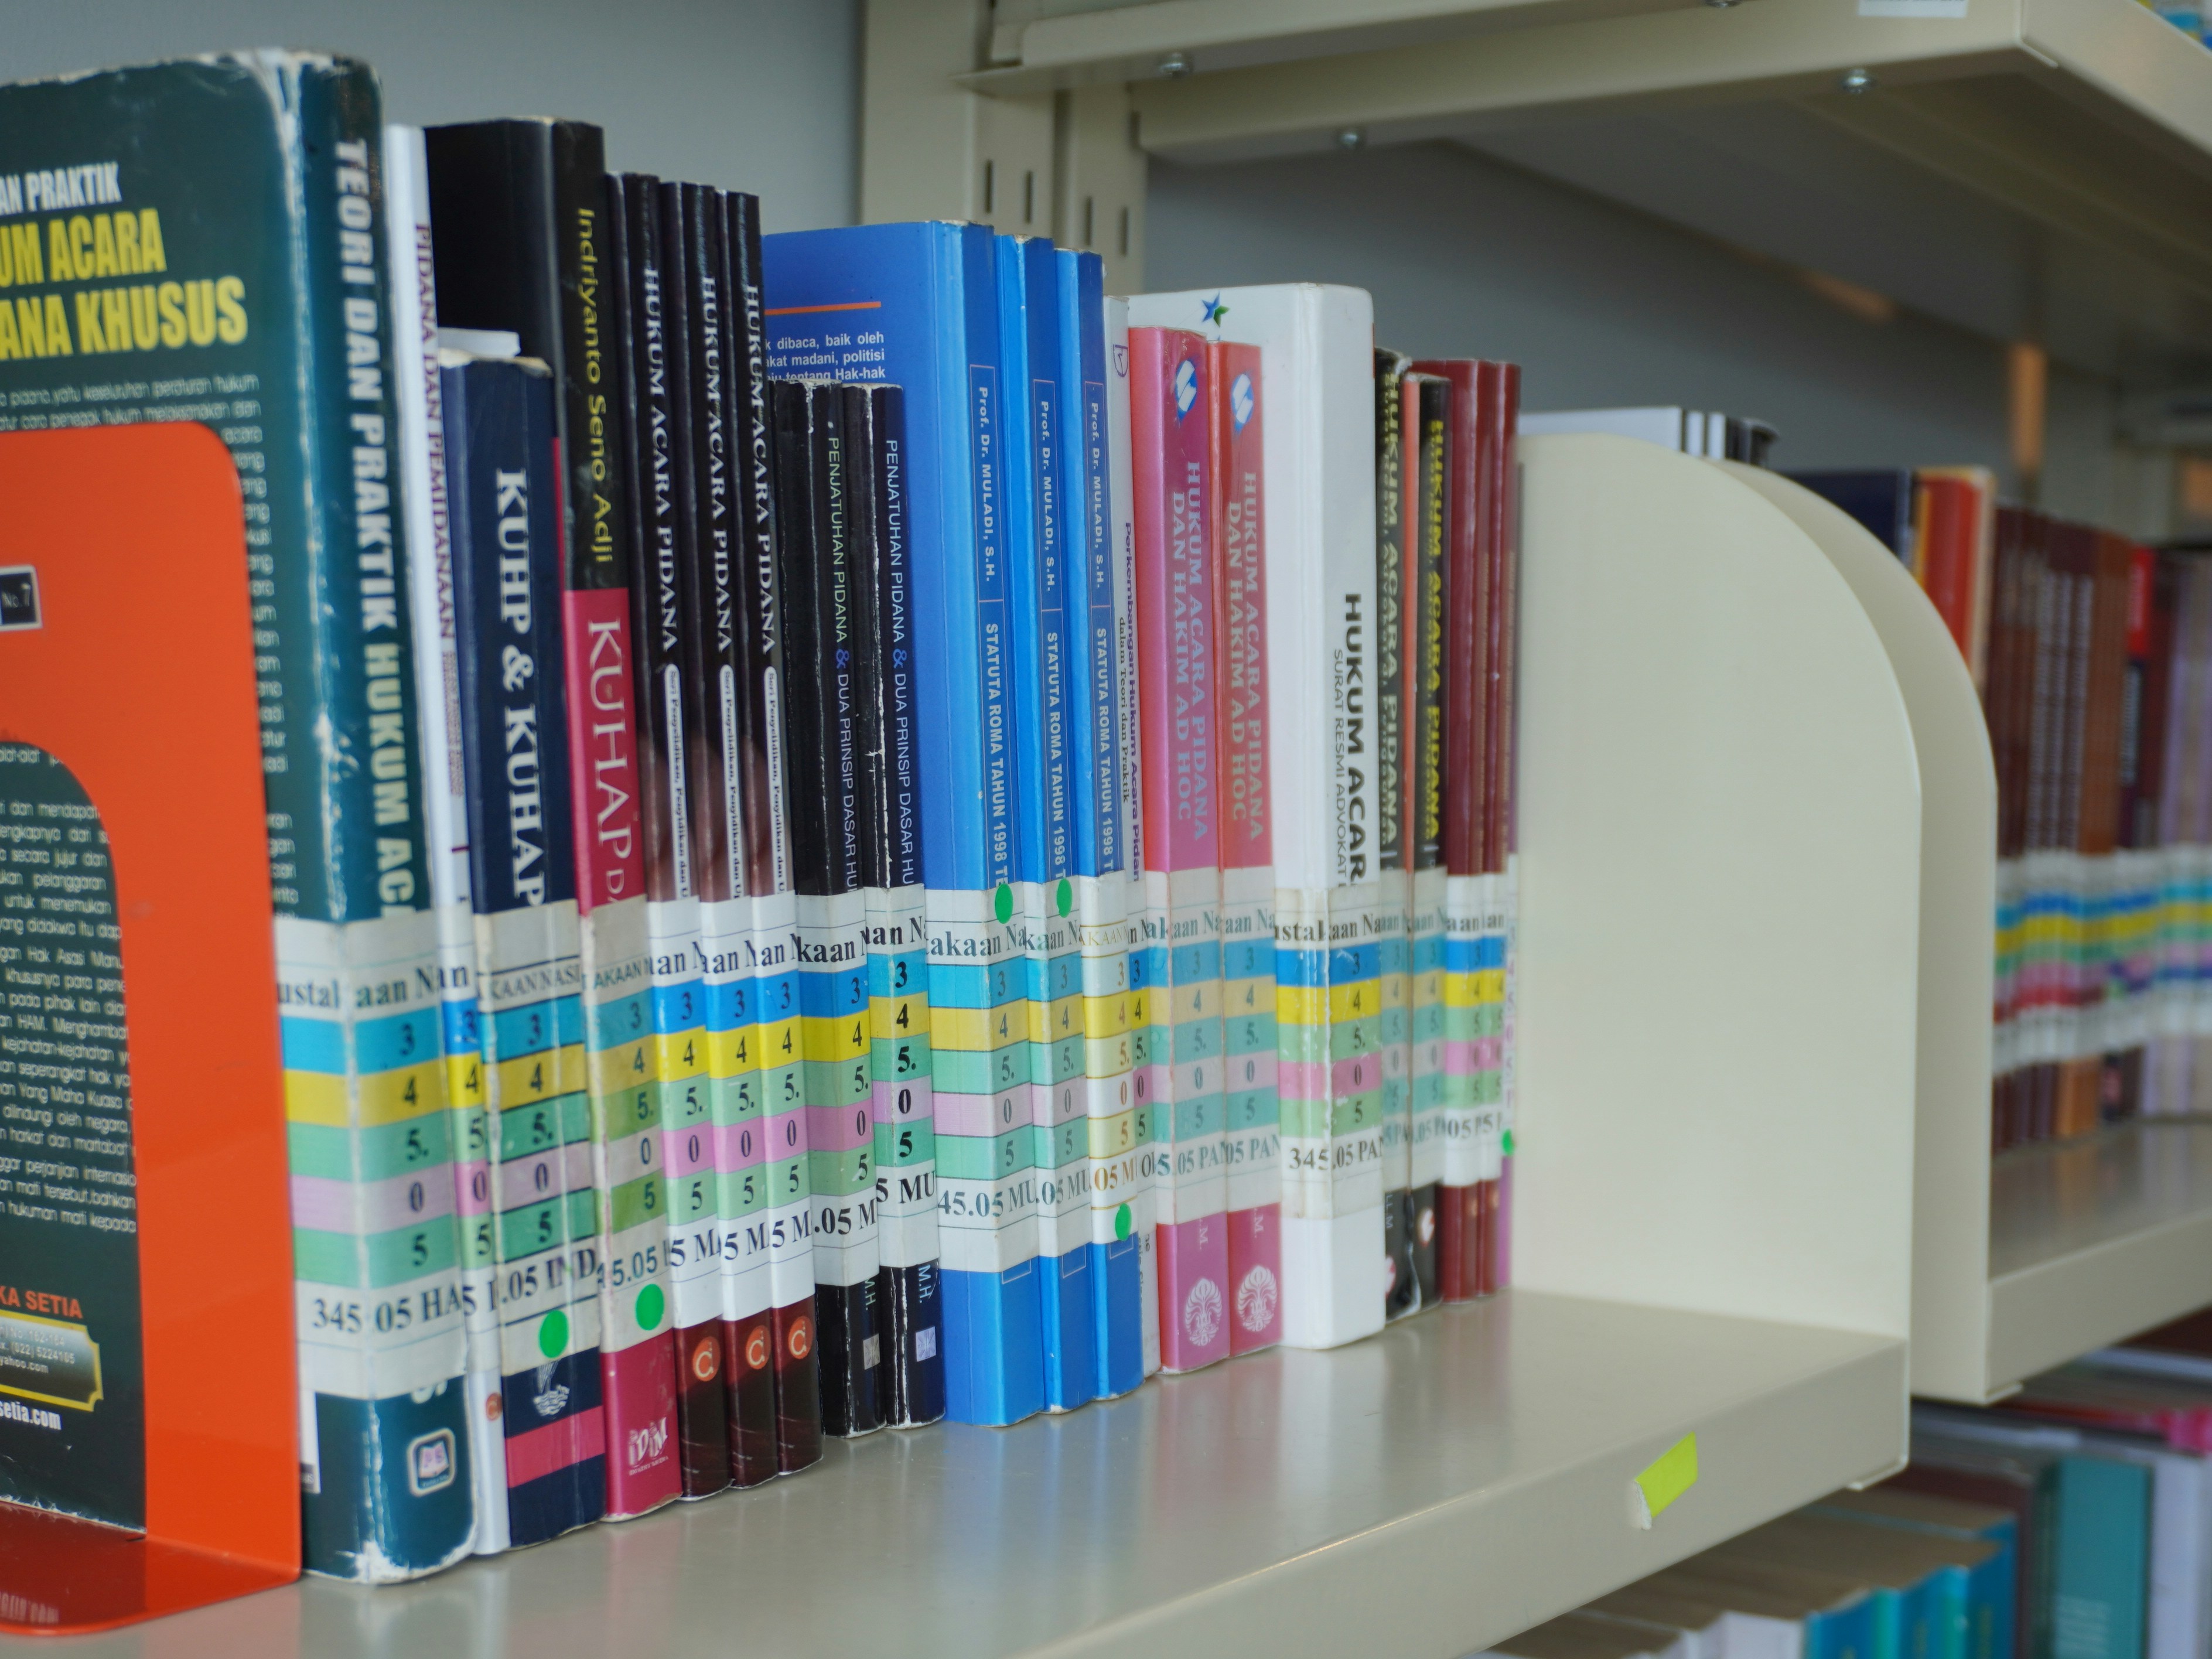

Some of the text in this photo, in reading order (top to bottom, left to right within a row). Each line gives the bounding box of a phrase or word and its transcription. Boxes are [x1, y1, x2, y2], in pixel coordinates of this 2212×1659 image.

[25, 161, 122, 212] PRAKTIK
[335, 137, 375, 285] TEORI
[50, 208, 167, 282] ACARA
[415, 224, 438, 343] PIDANA
[76, 276, 248, 354] KHUSUS
[777, 332, 884, 350] dibaca, baik oleh
[344, 298, 383, 400] DAN
[792, 349, 885, 366] madani, politisi
[836, 366, 886, 380] Hak-hak
[424, 354, 442, 419] DAN
[578, 209, 613, 561] Indriyanto Seno Adji
[644, 267, 678, 653] HUKUM ACARA PIDANA
[703, 276, 732, 652] HUKUM ACARA PIDANA
[746, 284, 776, 654] HUKUM ACARA PIDANA
[1092, 448, 1100, 470] Dr.
[351, 414, 398, 631] PRAKTIK
[886, 439, 902, 566] PENJATUHAN
[1094, 476, 1102, 548] MULADI,
[428, 433, 455, 638] PEMIDANAAN
[892, 571, 905, 643] PIDANA
[979, 387, 1007, 861] Prof. Dr. MULADI, S.H. STATUTA ROMA TAHUN 1998
[1041, 401, 1065, 865] Prof. Dr. MULADI, S.H. STATUTA ROMA TAHUN 1998
[828, 436, 856, 858] PENJATUHAN PIDANA & DUA PRINSIP DASAR
[893, 648, 907, 669] &
[1097, 629, 1109, 702] STATUTA
[1173, 491, 1191, 820] DAN HAKIM AD HOC
[1188, 461, 1208, 841] HUKUM ACARA PIDANA
[1228, 502, 1246, 821] DAN HAKIM AD HOC
[1245, 472, 1264, 841] HUKUM ACARA PIDANA
[1346, 593, 1364, 753] HUKUM
[497, 469, 545, 907] KUHP & KUHAP
[895, 674, 906, 711] DUA
[364, 643, 409, 826] HUKUM
[588, 620, 632, 859] KUHAP
[896, 717, 910, 787] PRINSIP
[1100, 706, 1110, 753] ROMA
[1101, 757, 1112, 813] TAHUN
[1333, 649, 1347, 876] SURAT RESMI ADVOKAT
[899, 793, 913, 855] DASAR
[1103, 818, 1113, 855] 1998
[896, 961, 907, 988] 3
[1353, 953, 1360, 974] 3
[682, 991, 692, 1020] 3
[896, 1003, 909, 1029] 4
[1353, 989, 1360, 1011] 4
[400, 1023, 415, 1056] 3
[683, 1039, 694, 1066] 4
[898, 1046, 916, 1073] 5.
[402, 1076, 417, 1107] 4
[687, 1087, 702, 1115] 5.
[899, 1089, 911, 1114] 0
[688, 1135, 699, 1162] 0
[900, 1131, 912, 1157] 5
[409, 1182, 424, 1212] 0
[692, 1181, 702, 1210] 5
[898, 1171, 936, 1203] MU
[414, 1234, 428, 1266] 5
[25, 1291, 83, 1319] SETIA
[919, 1265, 931, 1303] M.H.
